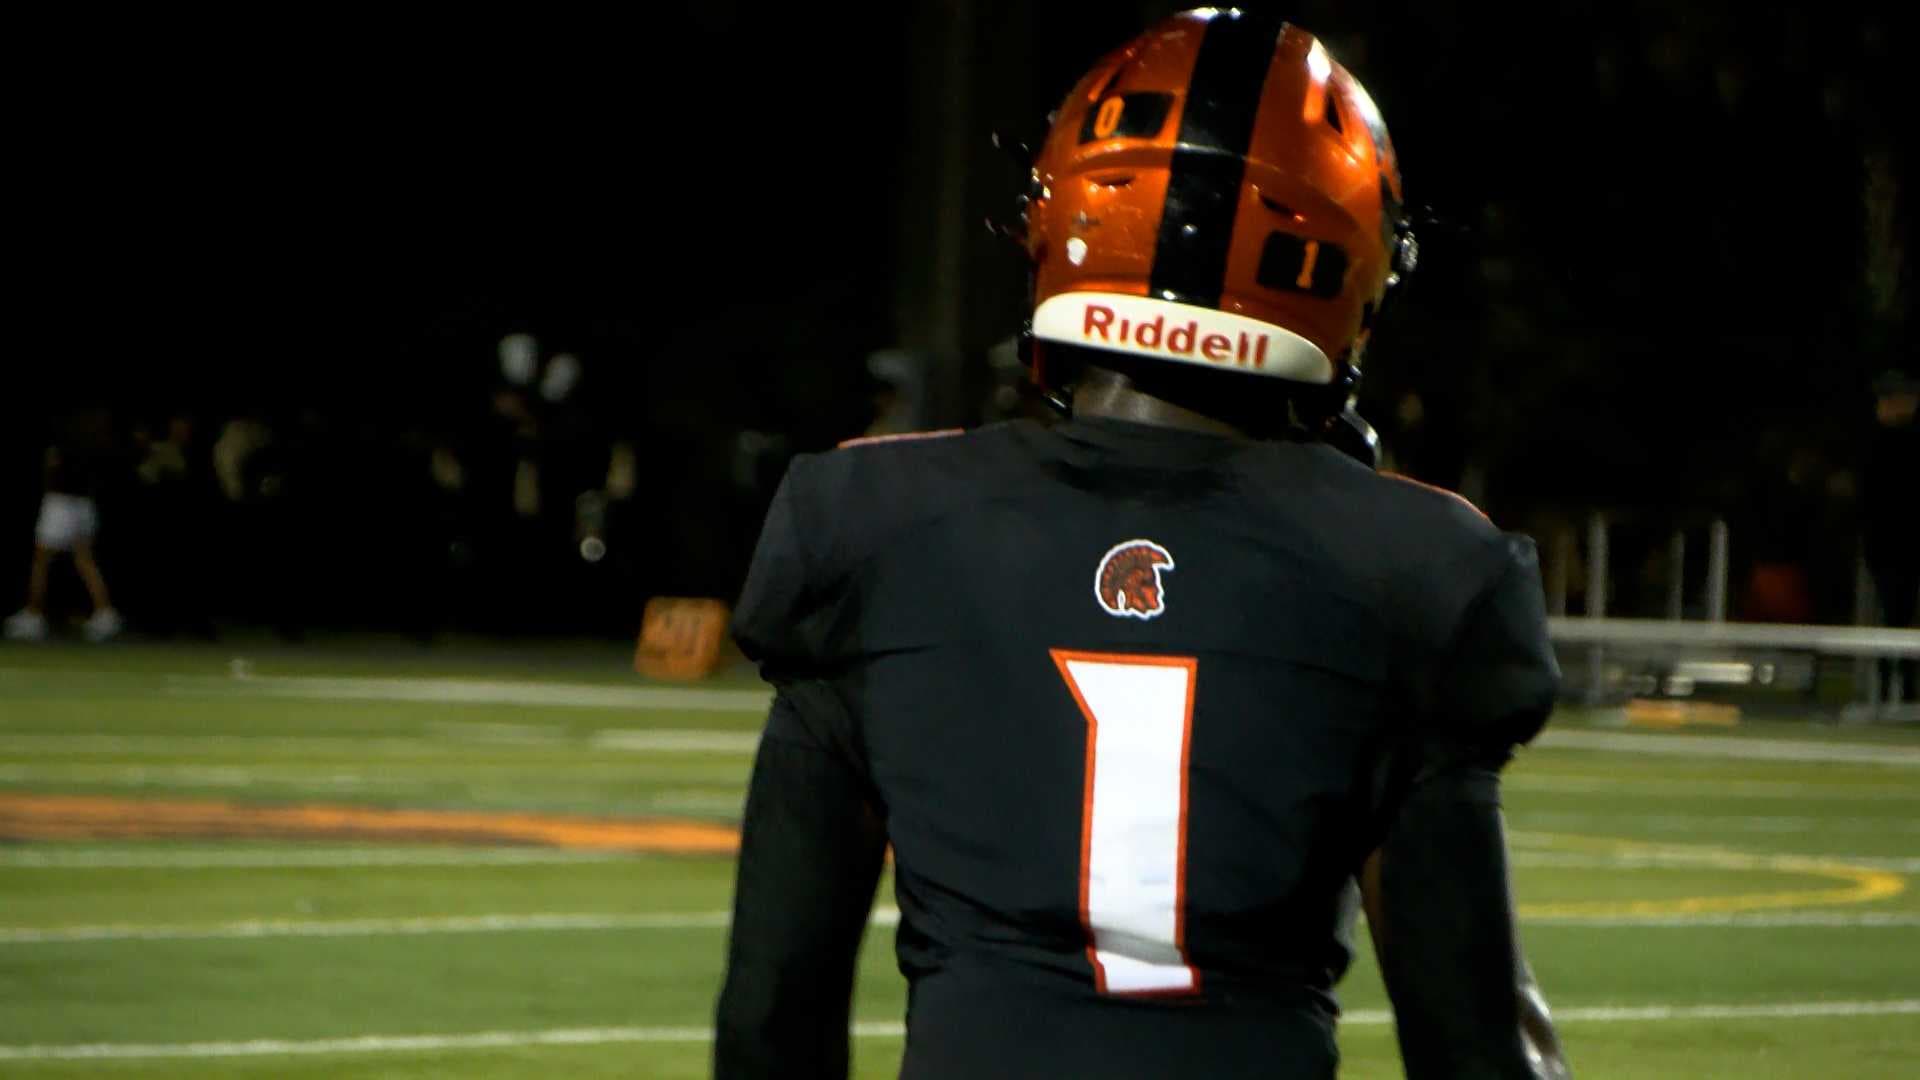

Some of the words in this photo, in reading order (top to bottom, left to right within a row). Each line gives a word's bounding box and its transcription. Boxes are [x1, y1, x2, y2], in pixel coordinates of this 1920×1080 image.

[1094, 97, 1124, 138] 0
[1297, 241, 1319, 288] 1
[1084, 304, 1269, 368] Riddell
[1049, 648, 1202, 996] 1
